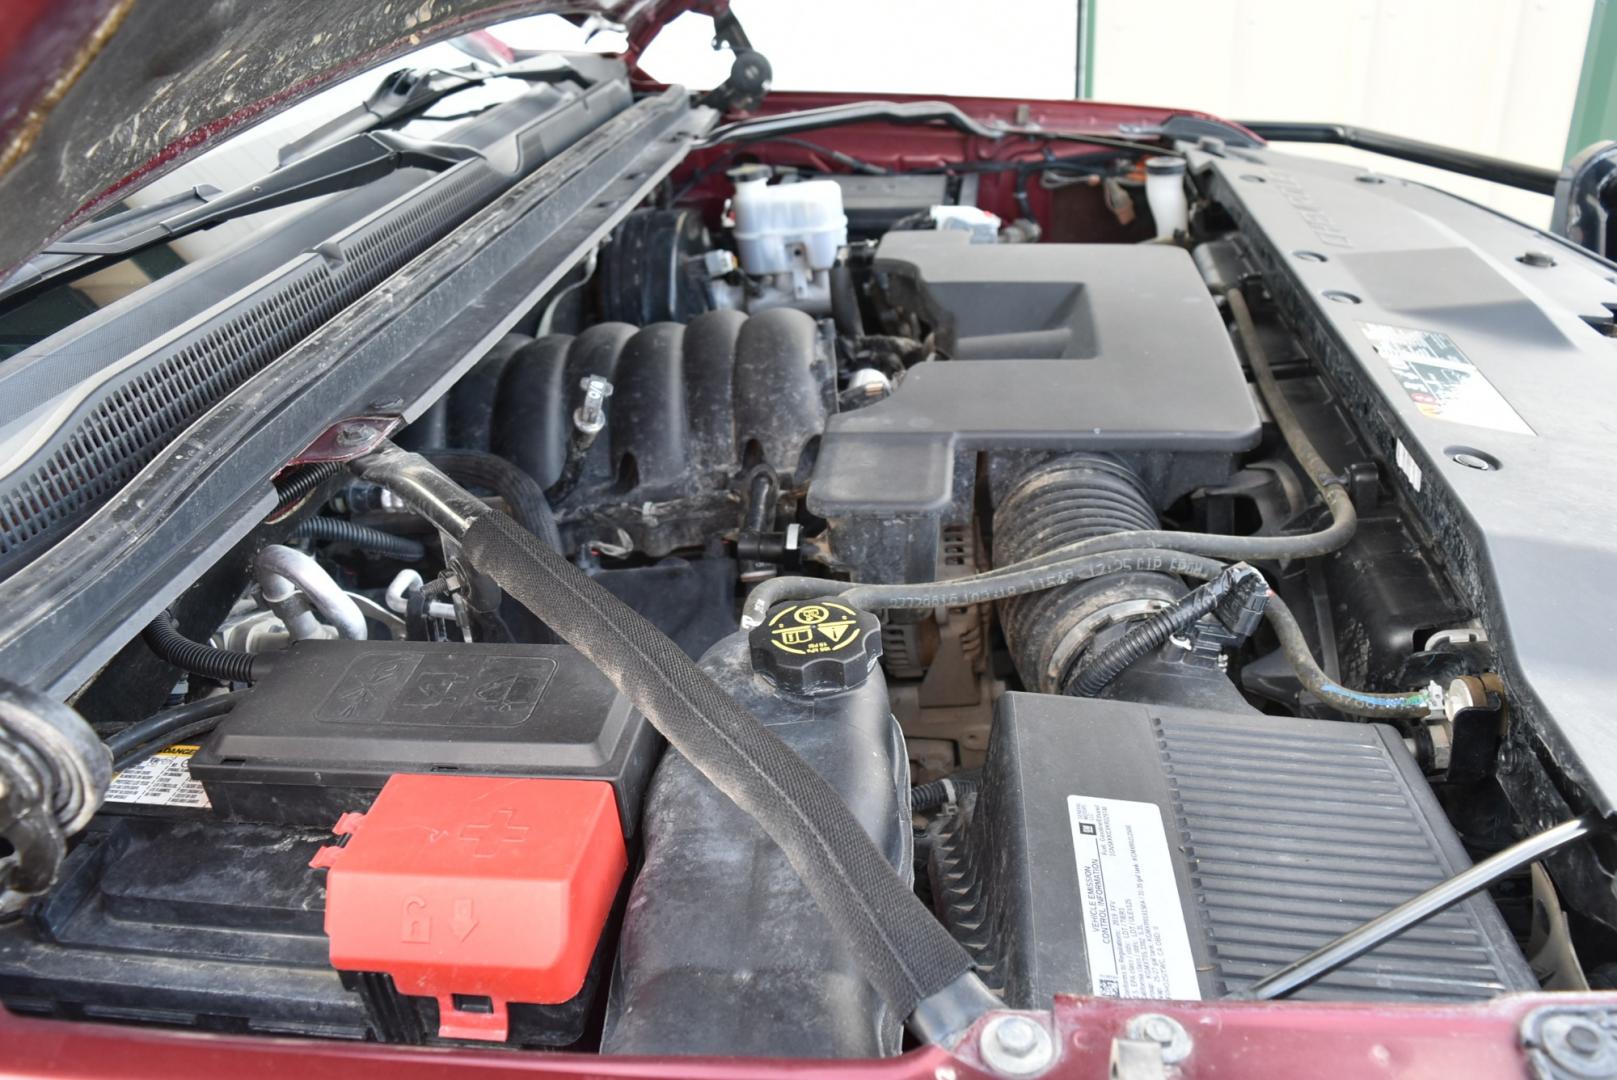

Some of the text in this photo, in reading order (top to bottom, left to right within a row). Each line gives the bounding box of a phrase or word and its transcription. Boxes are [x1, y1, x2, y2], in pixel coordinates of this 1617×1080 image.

[1083, 865, 1100, 933] VEHICLE EMISSION
[1090, 858, 1111, 945] CONTROL INFORMATION
